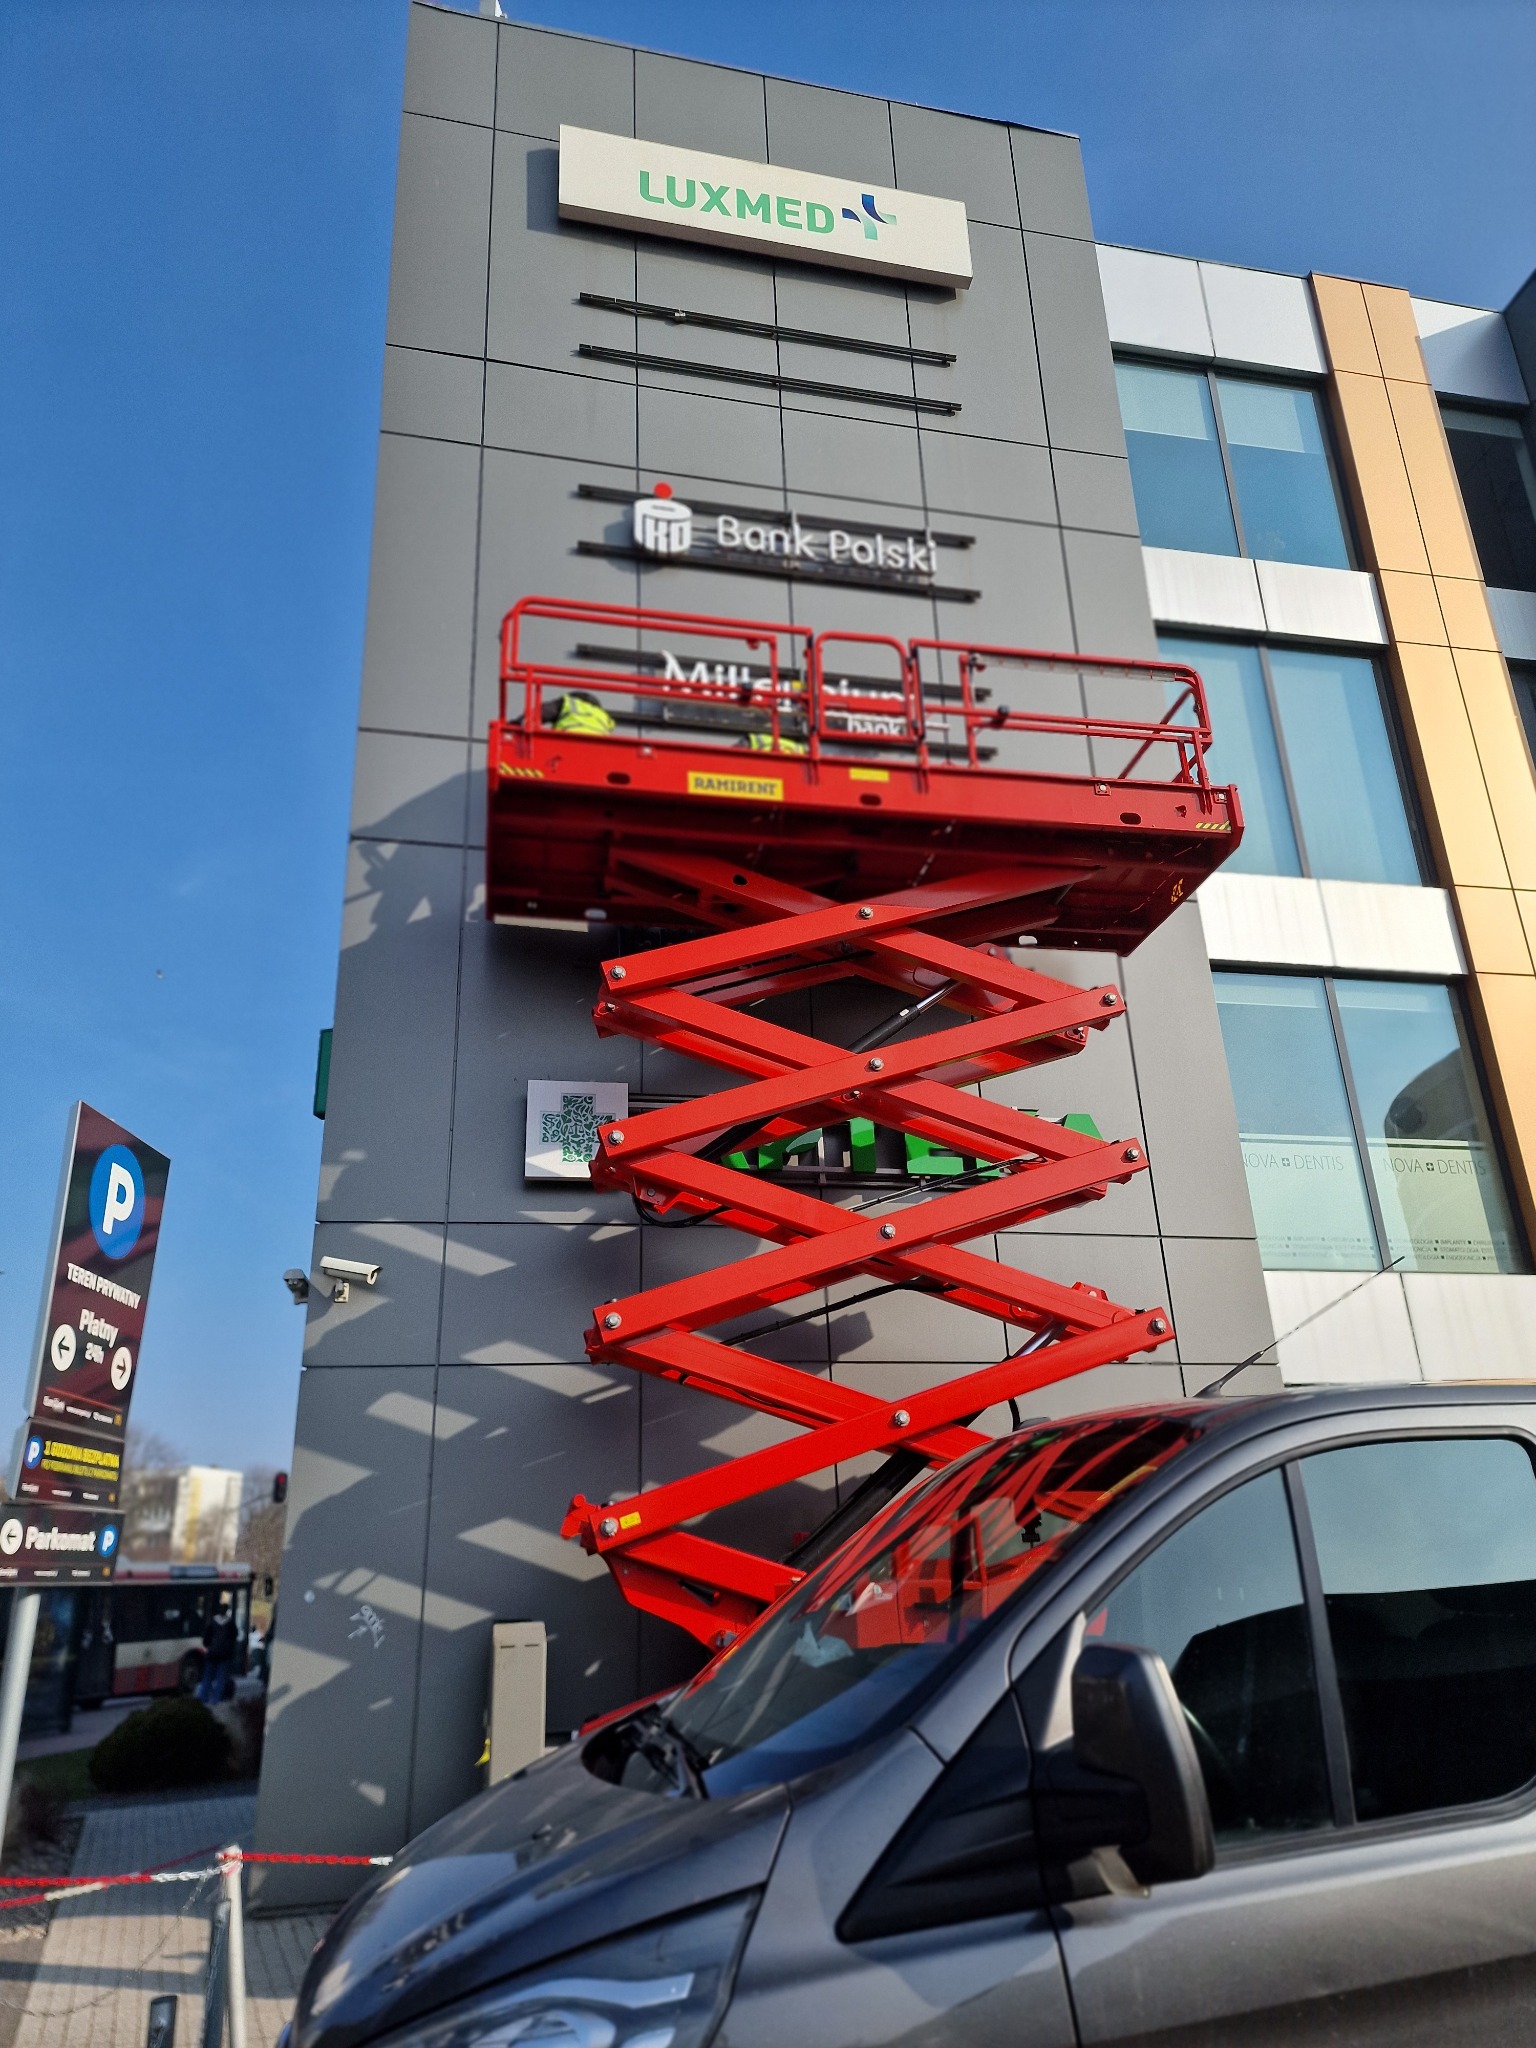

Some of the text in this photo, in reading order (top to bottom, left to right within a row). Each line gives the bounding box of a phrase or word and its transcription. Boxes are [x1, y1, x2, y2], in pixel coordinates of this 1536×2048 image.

[639, 170, 835, 234] LUXMED
[716, 514, 816, 558] Bank
[828, 529, 938, 572] Polski
[692, 776, 778, 796] RAMIRENT
[1293, 1154, 1344, 1171] DENTIS
[1437, 1159, 1487, 1176] DENTIS
[102, 1162, 135, 1235] P
[67, 1262, 141, 1310] TEREN PRYWATNY
[25, 1526, 97, 1551] Parkomat
